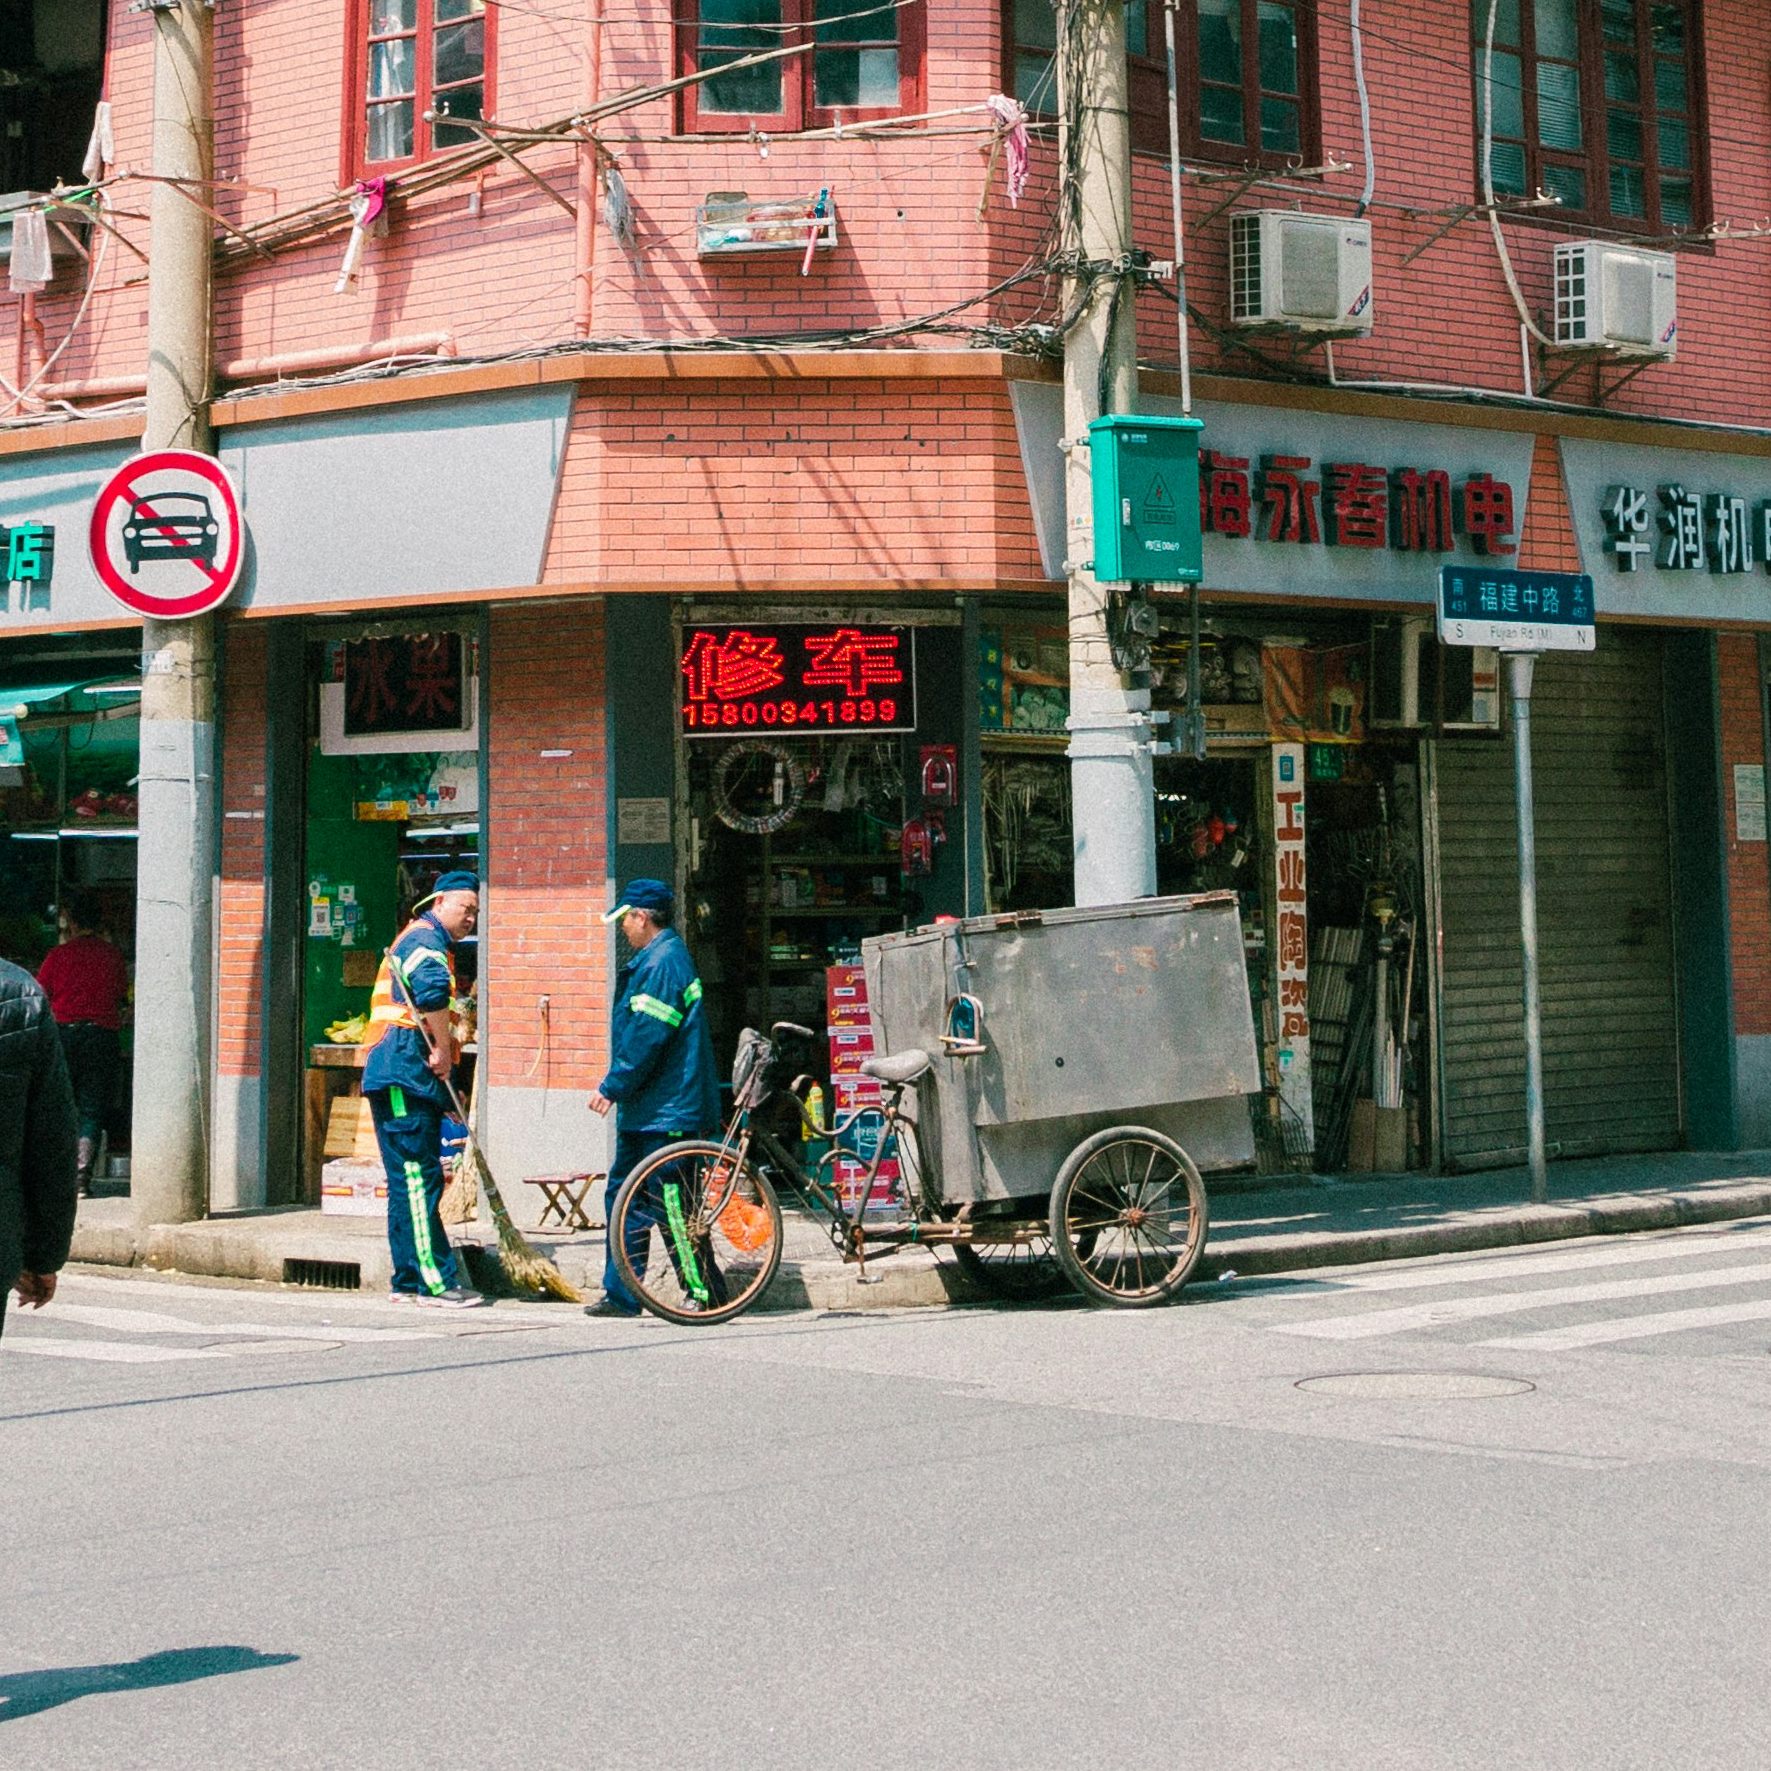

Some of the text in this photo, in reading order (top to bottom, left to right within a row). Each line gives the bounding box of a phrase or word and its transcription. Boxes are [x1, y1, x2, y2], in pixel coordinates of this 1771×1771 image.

[1452, 578, 1586, 615] 南 福建中路 北
[681, 629, 903, 701] 修车
[1455, 623, 1465, 639] S
[1521, 627, 1534, 640] Rd
[1577, 630, 1587, 644] N
[350, 632, 456, 723] 水果
[1276, 790, 1310, 1037] 工业陶瓷
